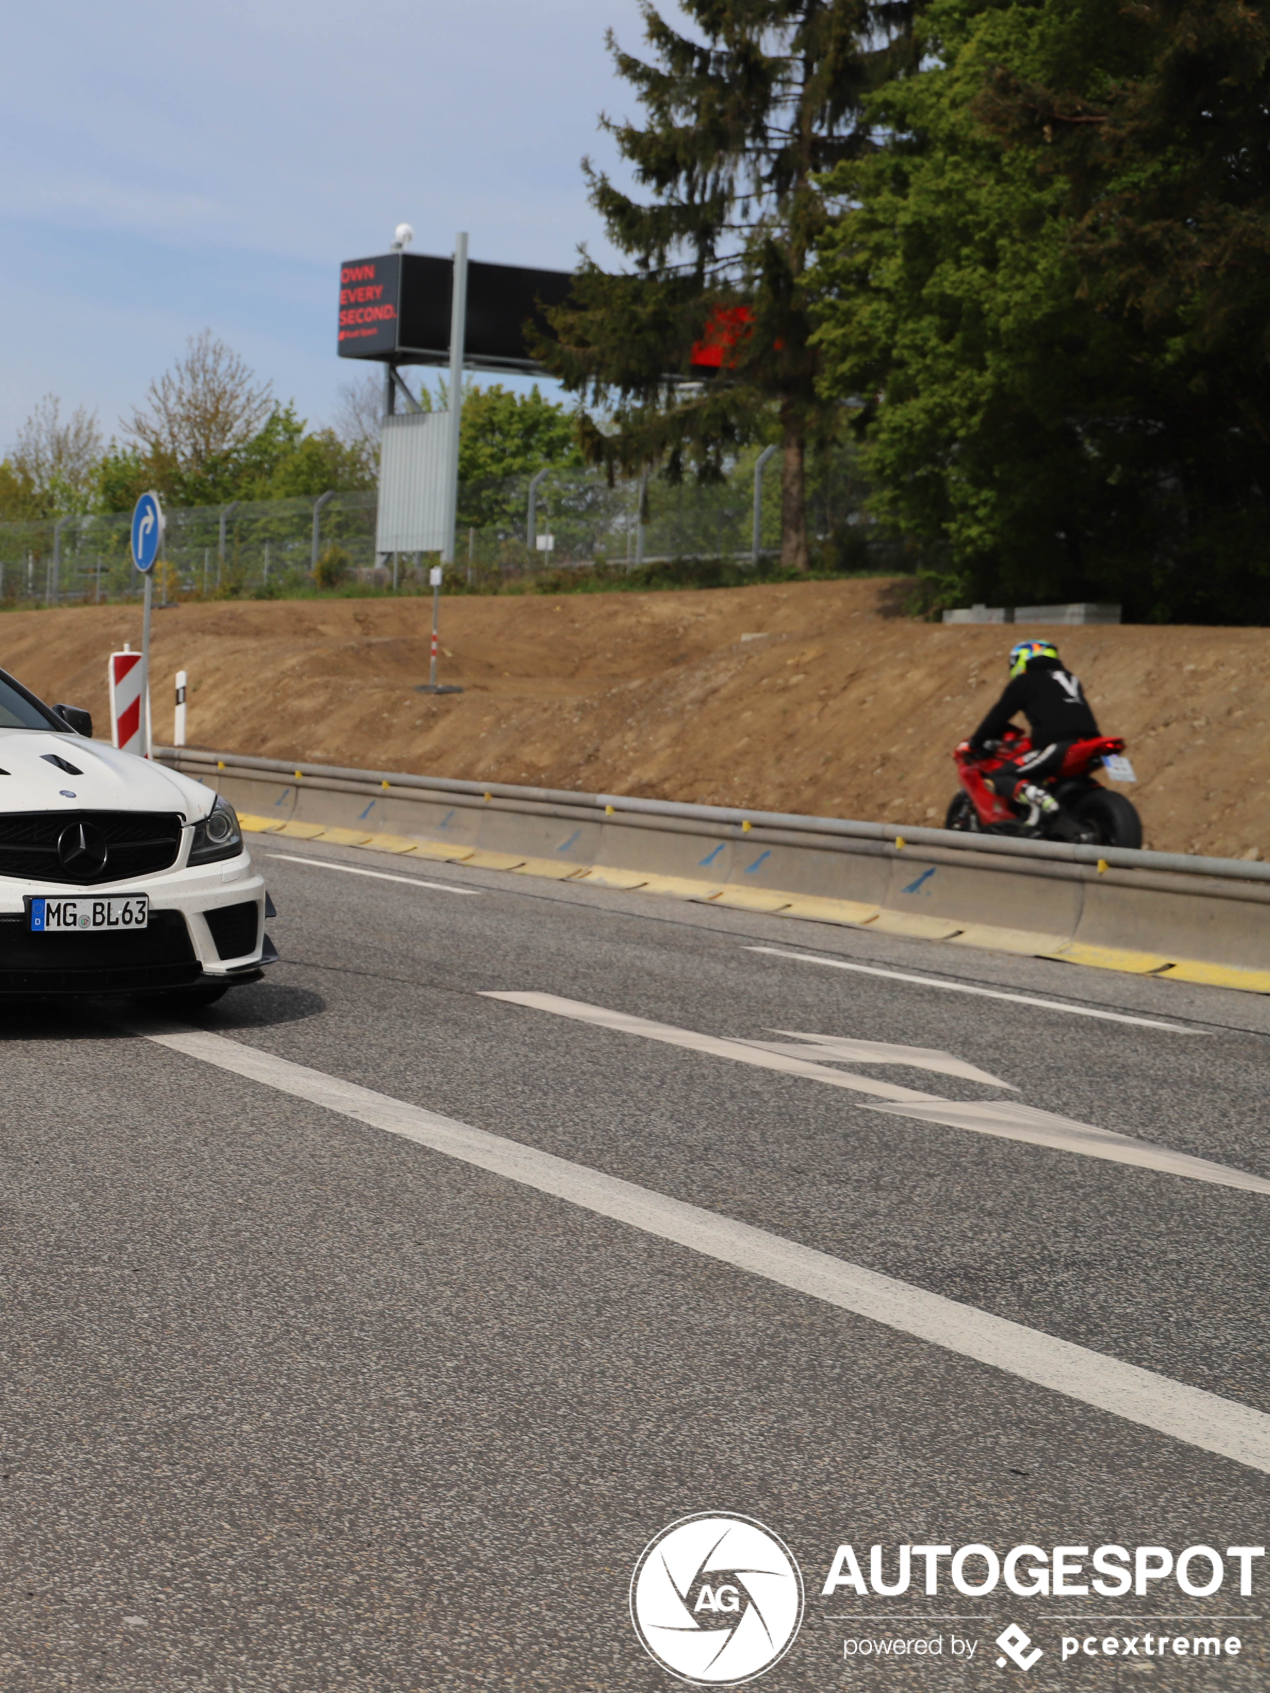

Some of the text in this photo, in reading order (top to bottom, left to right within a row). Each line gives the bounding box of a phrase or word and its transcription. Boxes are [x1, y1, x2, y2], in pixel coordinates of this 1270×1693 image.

[341, 264, 375, 284] OWN
[340, 284, 384, 305] EVERY
[339, 304, 397, 326] SECOND.
[46, 903, 77, 926] MG
[92, 901, 146, 926] BL63
